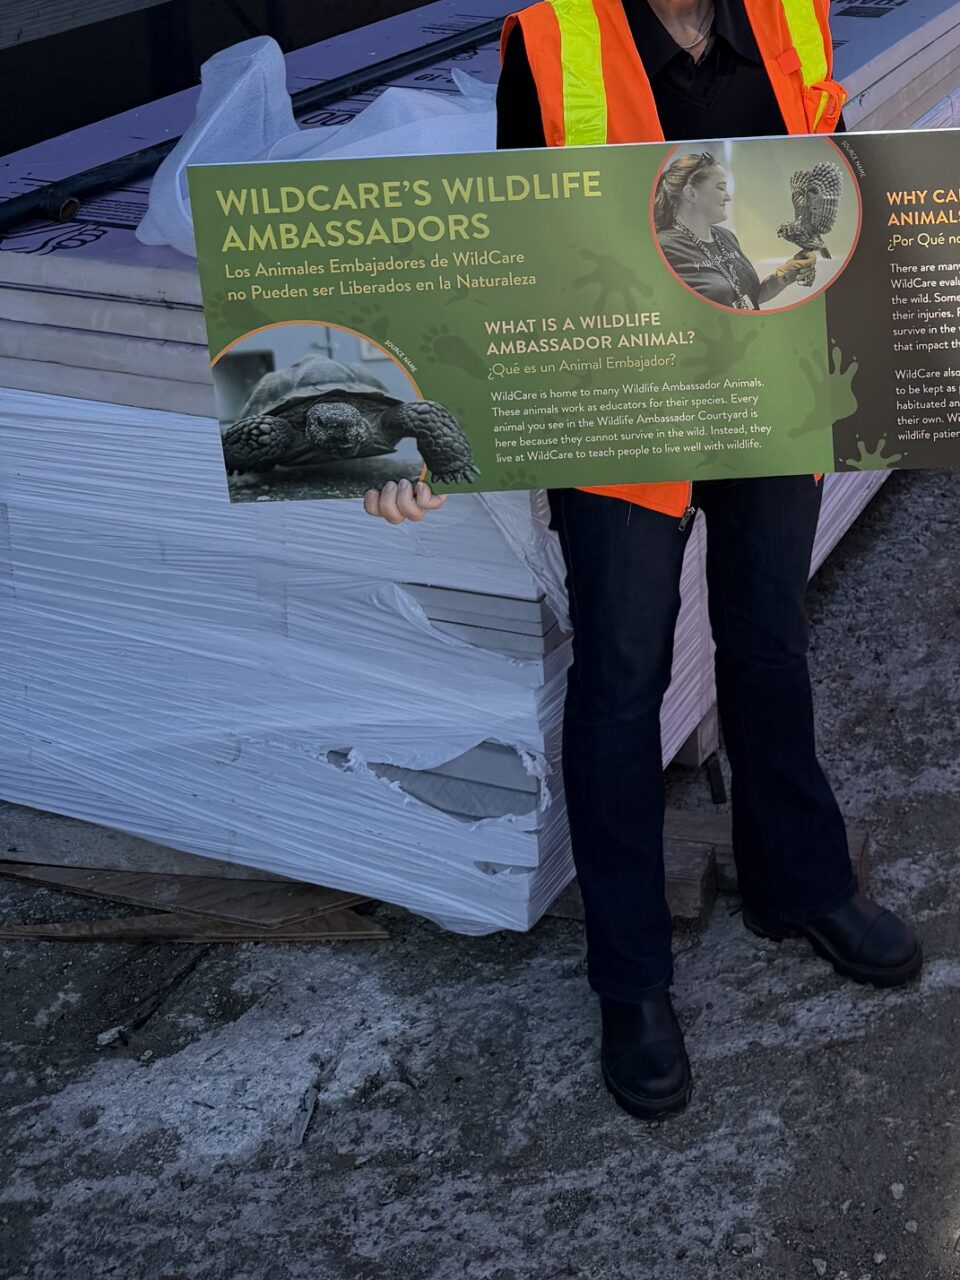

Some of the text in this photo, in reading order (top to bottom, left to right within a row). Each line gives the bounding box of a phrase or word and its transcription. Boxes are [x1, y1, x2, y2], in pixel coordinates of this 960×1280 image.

[215, 170, 601, 216] WILDCARE'S WILDLIFE
[886, 190, 927, 205] WHY
[221, 212, 489, 252] AMBASSADORS
[887, 234, 914, 251] ¿Por
[917, 232, 944, 248] Qué
[225, 249, 524, 278] Los Animales Embajadores de WildCare
[890, 263, 918, 272] There
[227, 271, 536, 300] no Pueden ser Liberados en la Naturaleza
[890, 277, 937, 288] WildCare
[484, 312, 660, 334] WHAT IS A WILDLIFE
[486, 330, 694, 355] AMBASSADOR ANIMAL?
[487, 352, 675, 380] ¿Qué es un Animal Embajador?
[894, 368, 940, 379] WildCare
[943, 367, 960, 377] also
[490, 377, 764, 401] WildCare is home to many Wildlife Ambassador Animals.
[491, 406, 520, 416] These
[523, 404, 558, 415] animals
[561, 402, 584, 412] work
[599, 400, 647, 410] educators
[649, 397, 663, 407] for
[665, 396, 688, 407] their
[691, 397, 727, 408] species.
[730, 393, 758, 405] Every
[897, 429, 930, 440] wildlife
